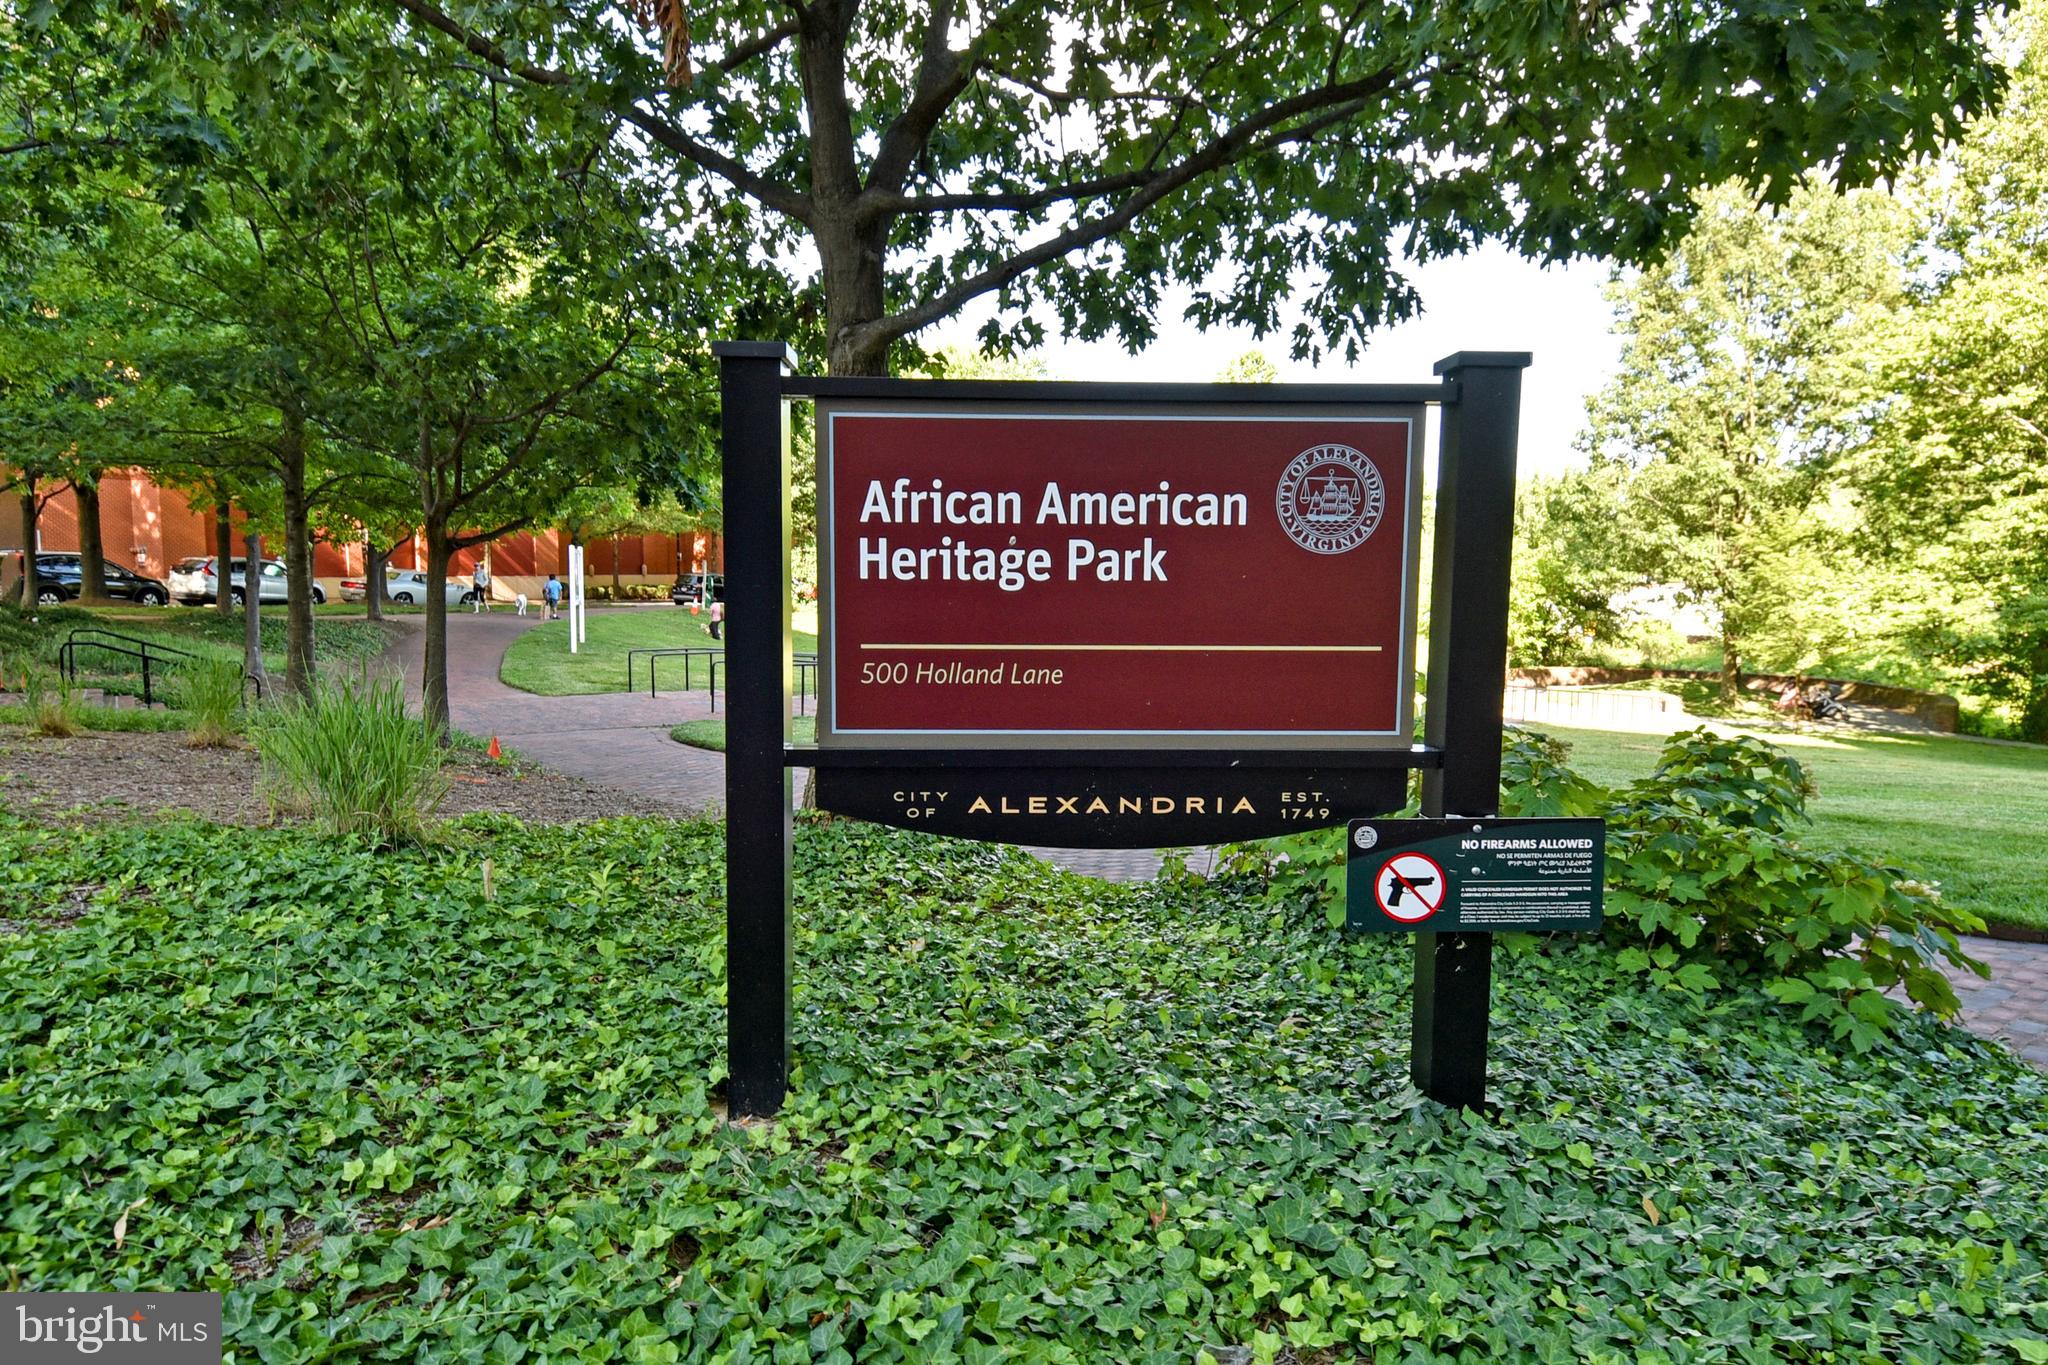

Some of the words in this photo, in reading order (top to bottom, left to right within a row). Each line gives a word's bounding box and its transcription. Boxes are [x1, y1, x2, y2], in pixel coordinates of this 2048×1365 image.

[1280, 475, 1295, 518] CITY
[1290, 456, 1311, 478] OF
[1311, 447, 1381, 518] ALEXANDRIA
[860, 479, 1021, 525] African
[1036, 480, 1247, 526] American
[1289, 521, 1371, 551] VIRGINIA
[859, 536, 1052, 592] Heritage
[1068, 537, 1168, 582] Park
[860, 662, 908, 685] 500
[915, 661, 1003, 685] Holland
[1010, 662, 1064, 685] Lane
[893, 791, 948, 802] CITY
[967, 796, 1257, 814] ALEXANDRIA
[1281, 792, 1330, 803] EST.
[906, 807, 936, 819] OF
[1280, 808, 1330, 819] 1749
[1461, 840, 1479, 850] NO
[1481, 840, 1537, 850] FIREARMS
[1539, 839, 1593, 849] ALLOWED
